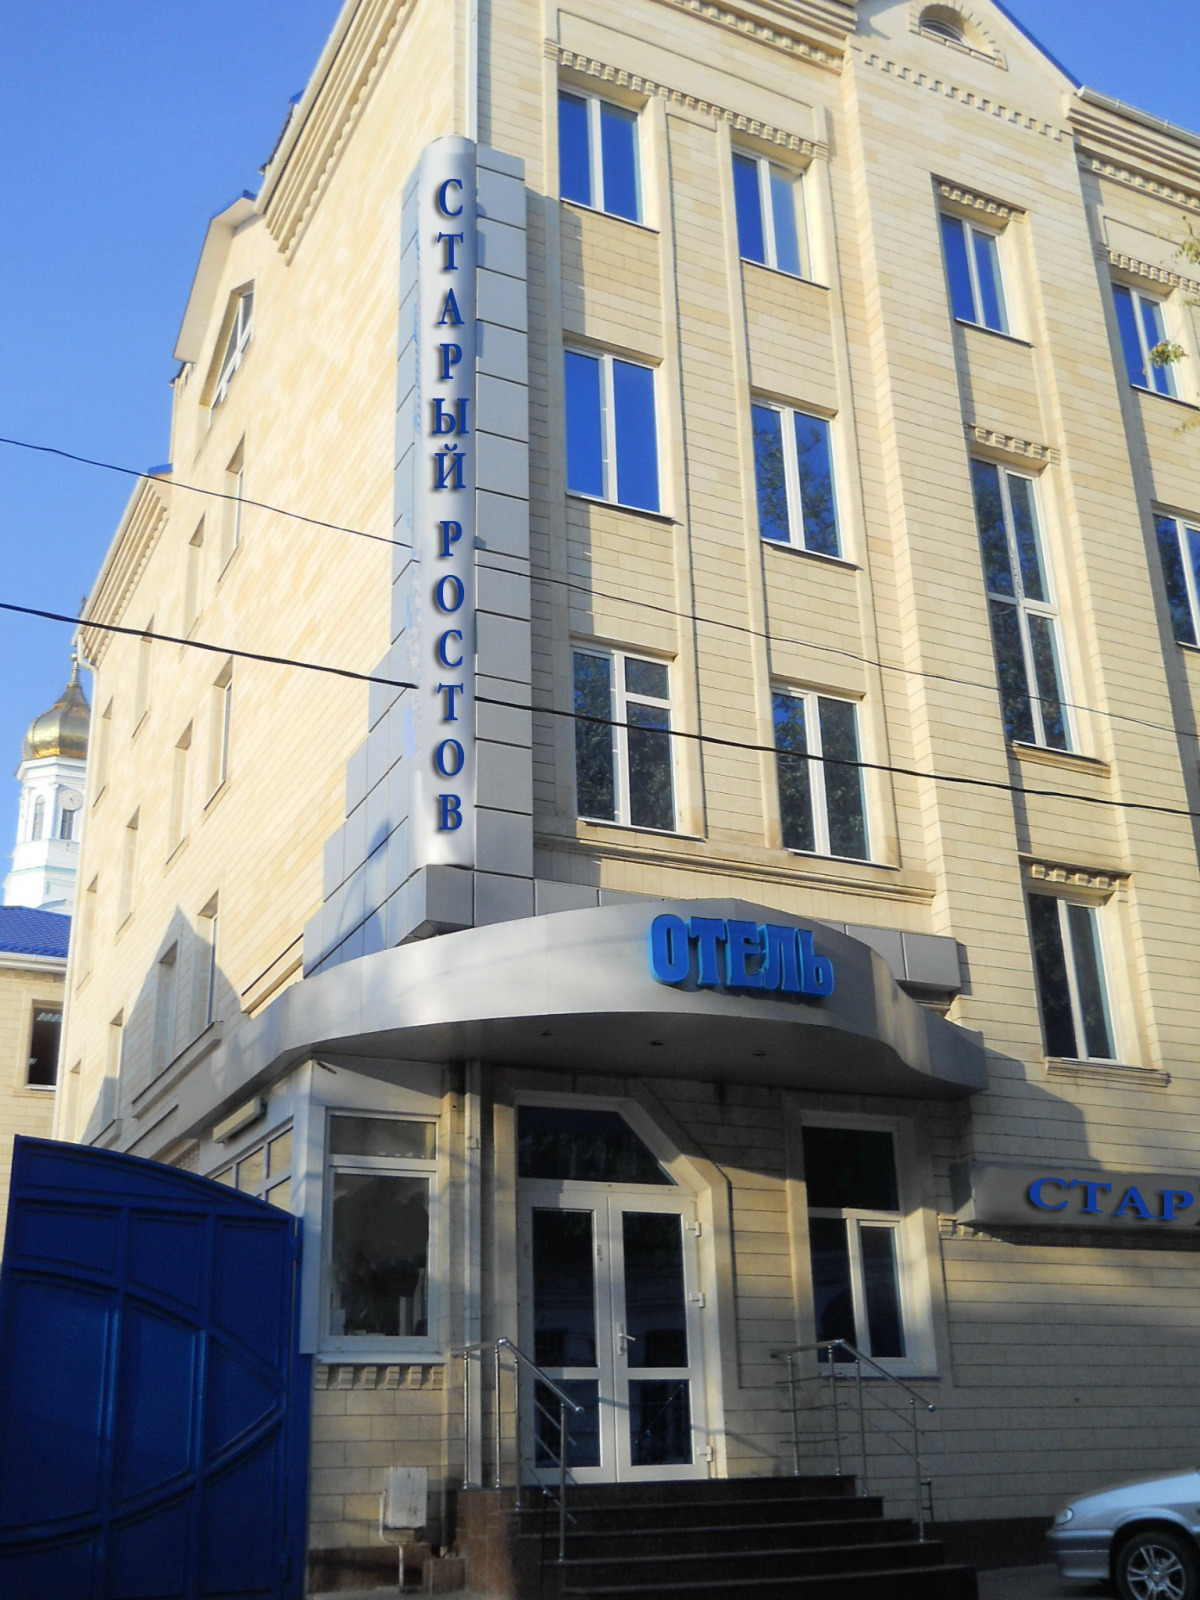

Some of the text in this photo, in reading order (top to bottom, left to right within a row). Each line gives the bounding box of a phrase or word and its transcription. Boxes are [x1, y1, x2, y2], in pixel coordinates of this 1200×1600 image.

[431, 178, 470, 831] СТАРЫЙ РОСТОВ
[648, 913, 835, 997] ОТЕЛЬ
[1029, 1177, 1195, 1221] СТАР
